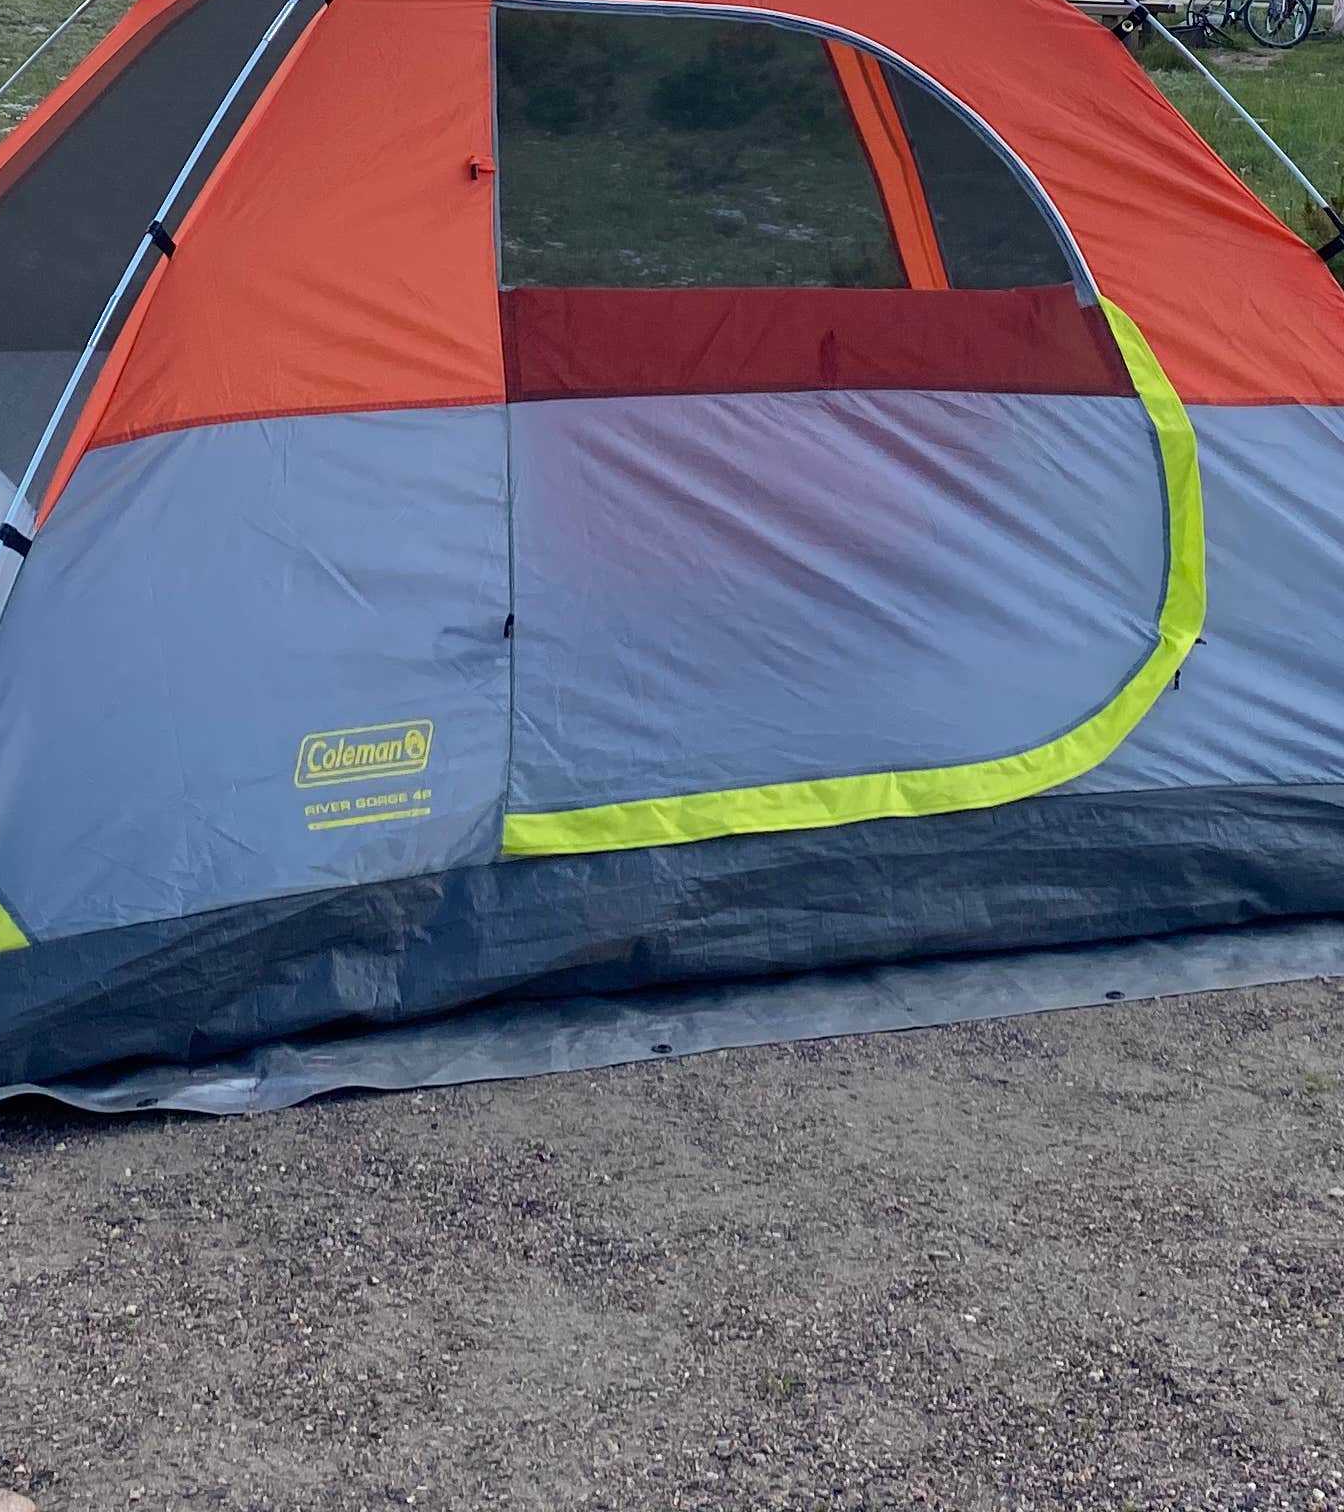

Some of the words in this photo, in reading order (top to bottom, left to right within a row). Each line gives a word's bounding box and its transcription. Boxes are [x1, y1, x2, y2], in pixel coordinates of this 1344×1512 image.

[307, 737, 403, 772] Coleman
[305, 800, 351, 817] RIVER
[355, 792, 408, 809] GORGE
[412, 789, 432, 801] 4P
